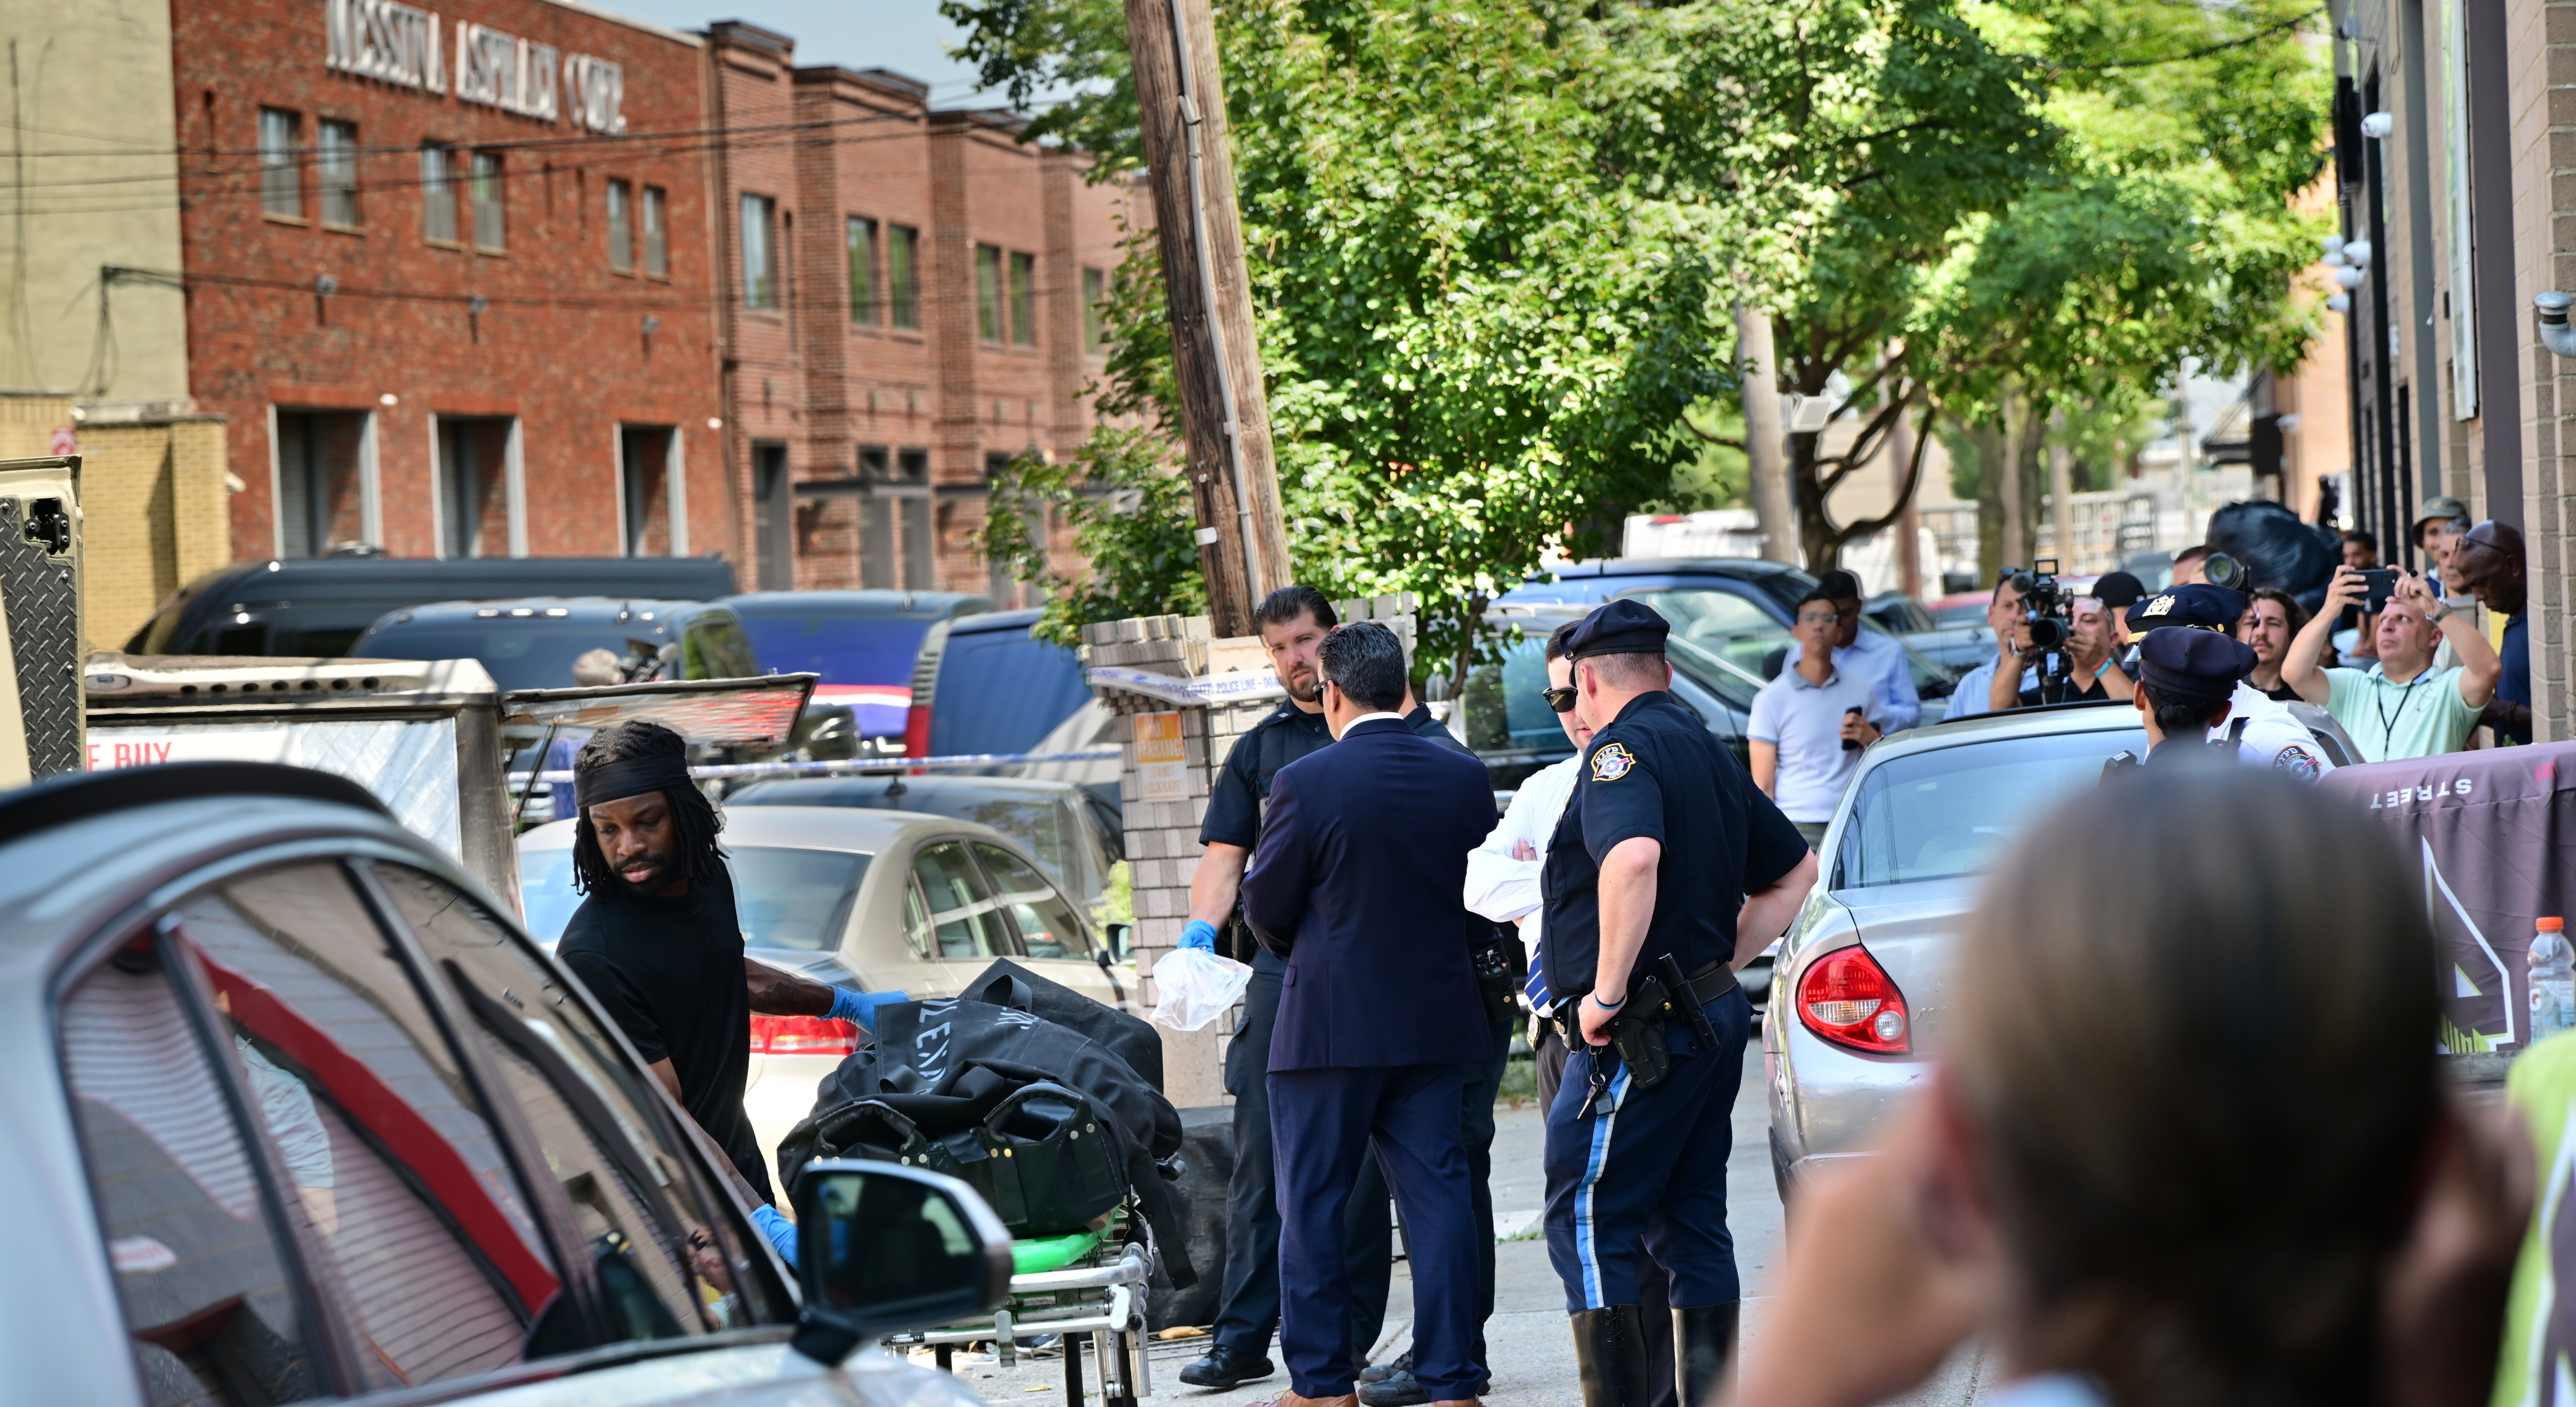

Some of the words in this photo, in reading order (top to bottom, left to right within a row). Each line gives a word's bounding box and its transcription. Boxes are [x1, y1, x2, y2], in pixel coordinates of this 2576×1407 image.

[1595, 746, 1619, 764] NYPD
[1599, 753, 1619, 765] HIGHWAY
[2275, 747, 2298, 770] NYPD
[1609, 770, 1625, 779] PATROL
[2370, 779, 2472, 809] STREET
